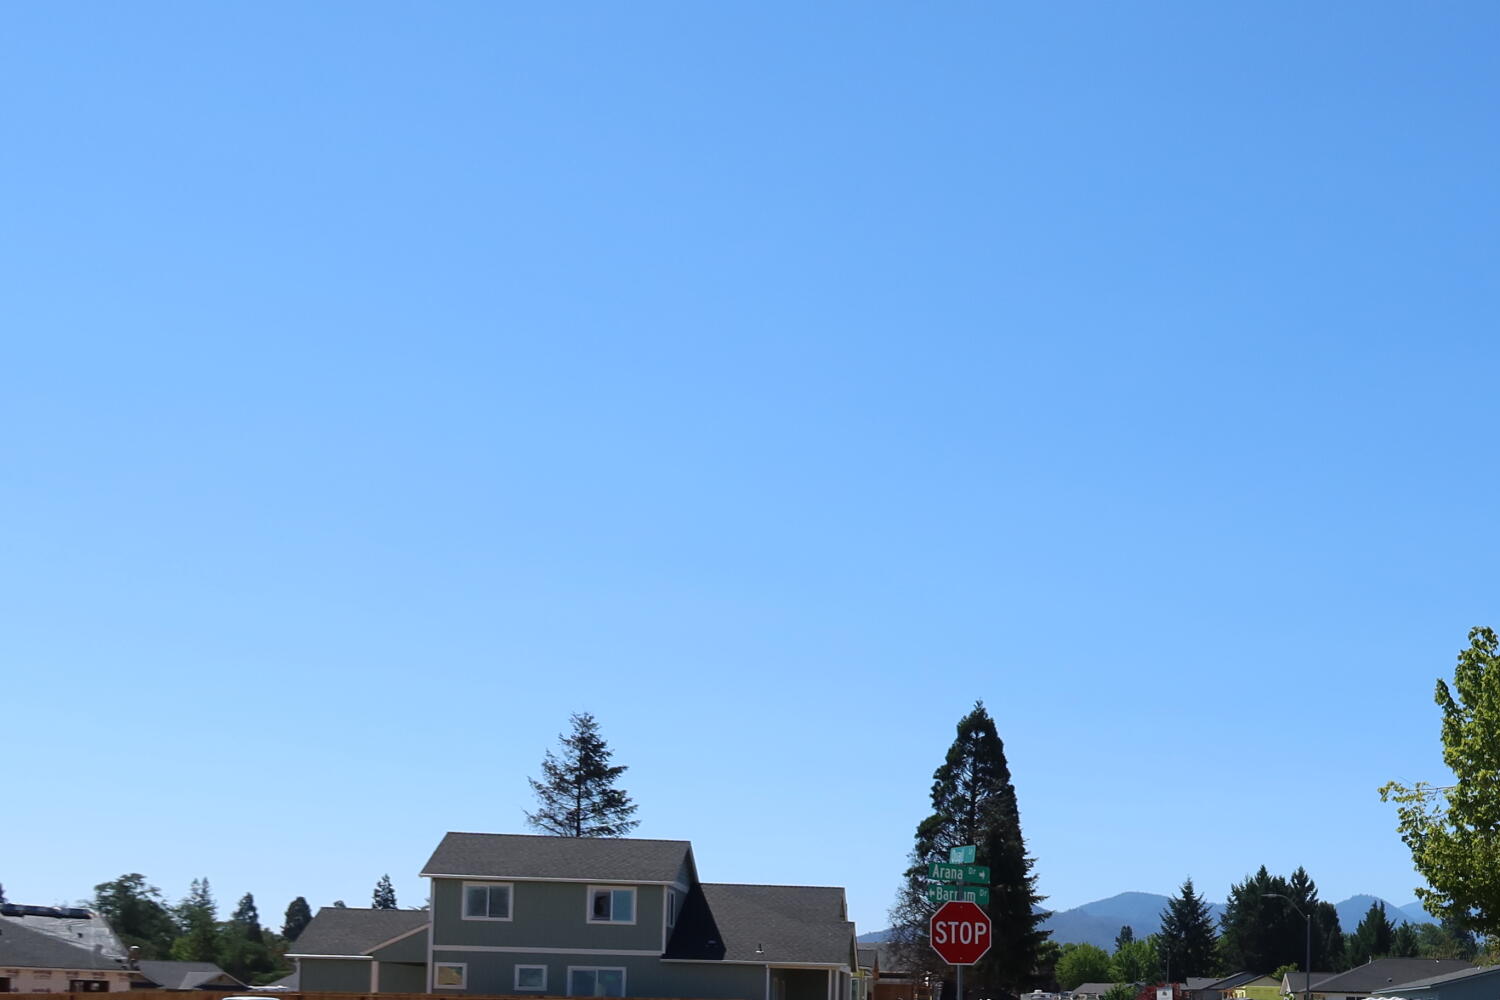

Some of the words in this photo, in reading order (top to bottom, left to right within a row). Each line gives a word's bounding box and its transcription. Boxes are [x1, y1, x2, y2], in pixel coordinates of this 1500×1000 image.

[932, 863, 963, 880] Arana
[968, 866, 976, 875] Dr
[980, 888, 987, 897] Dr
[935, 921, 987, 945] STOP
